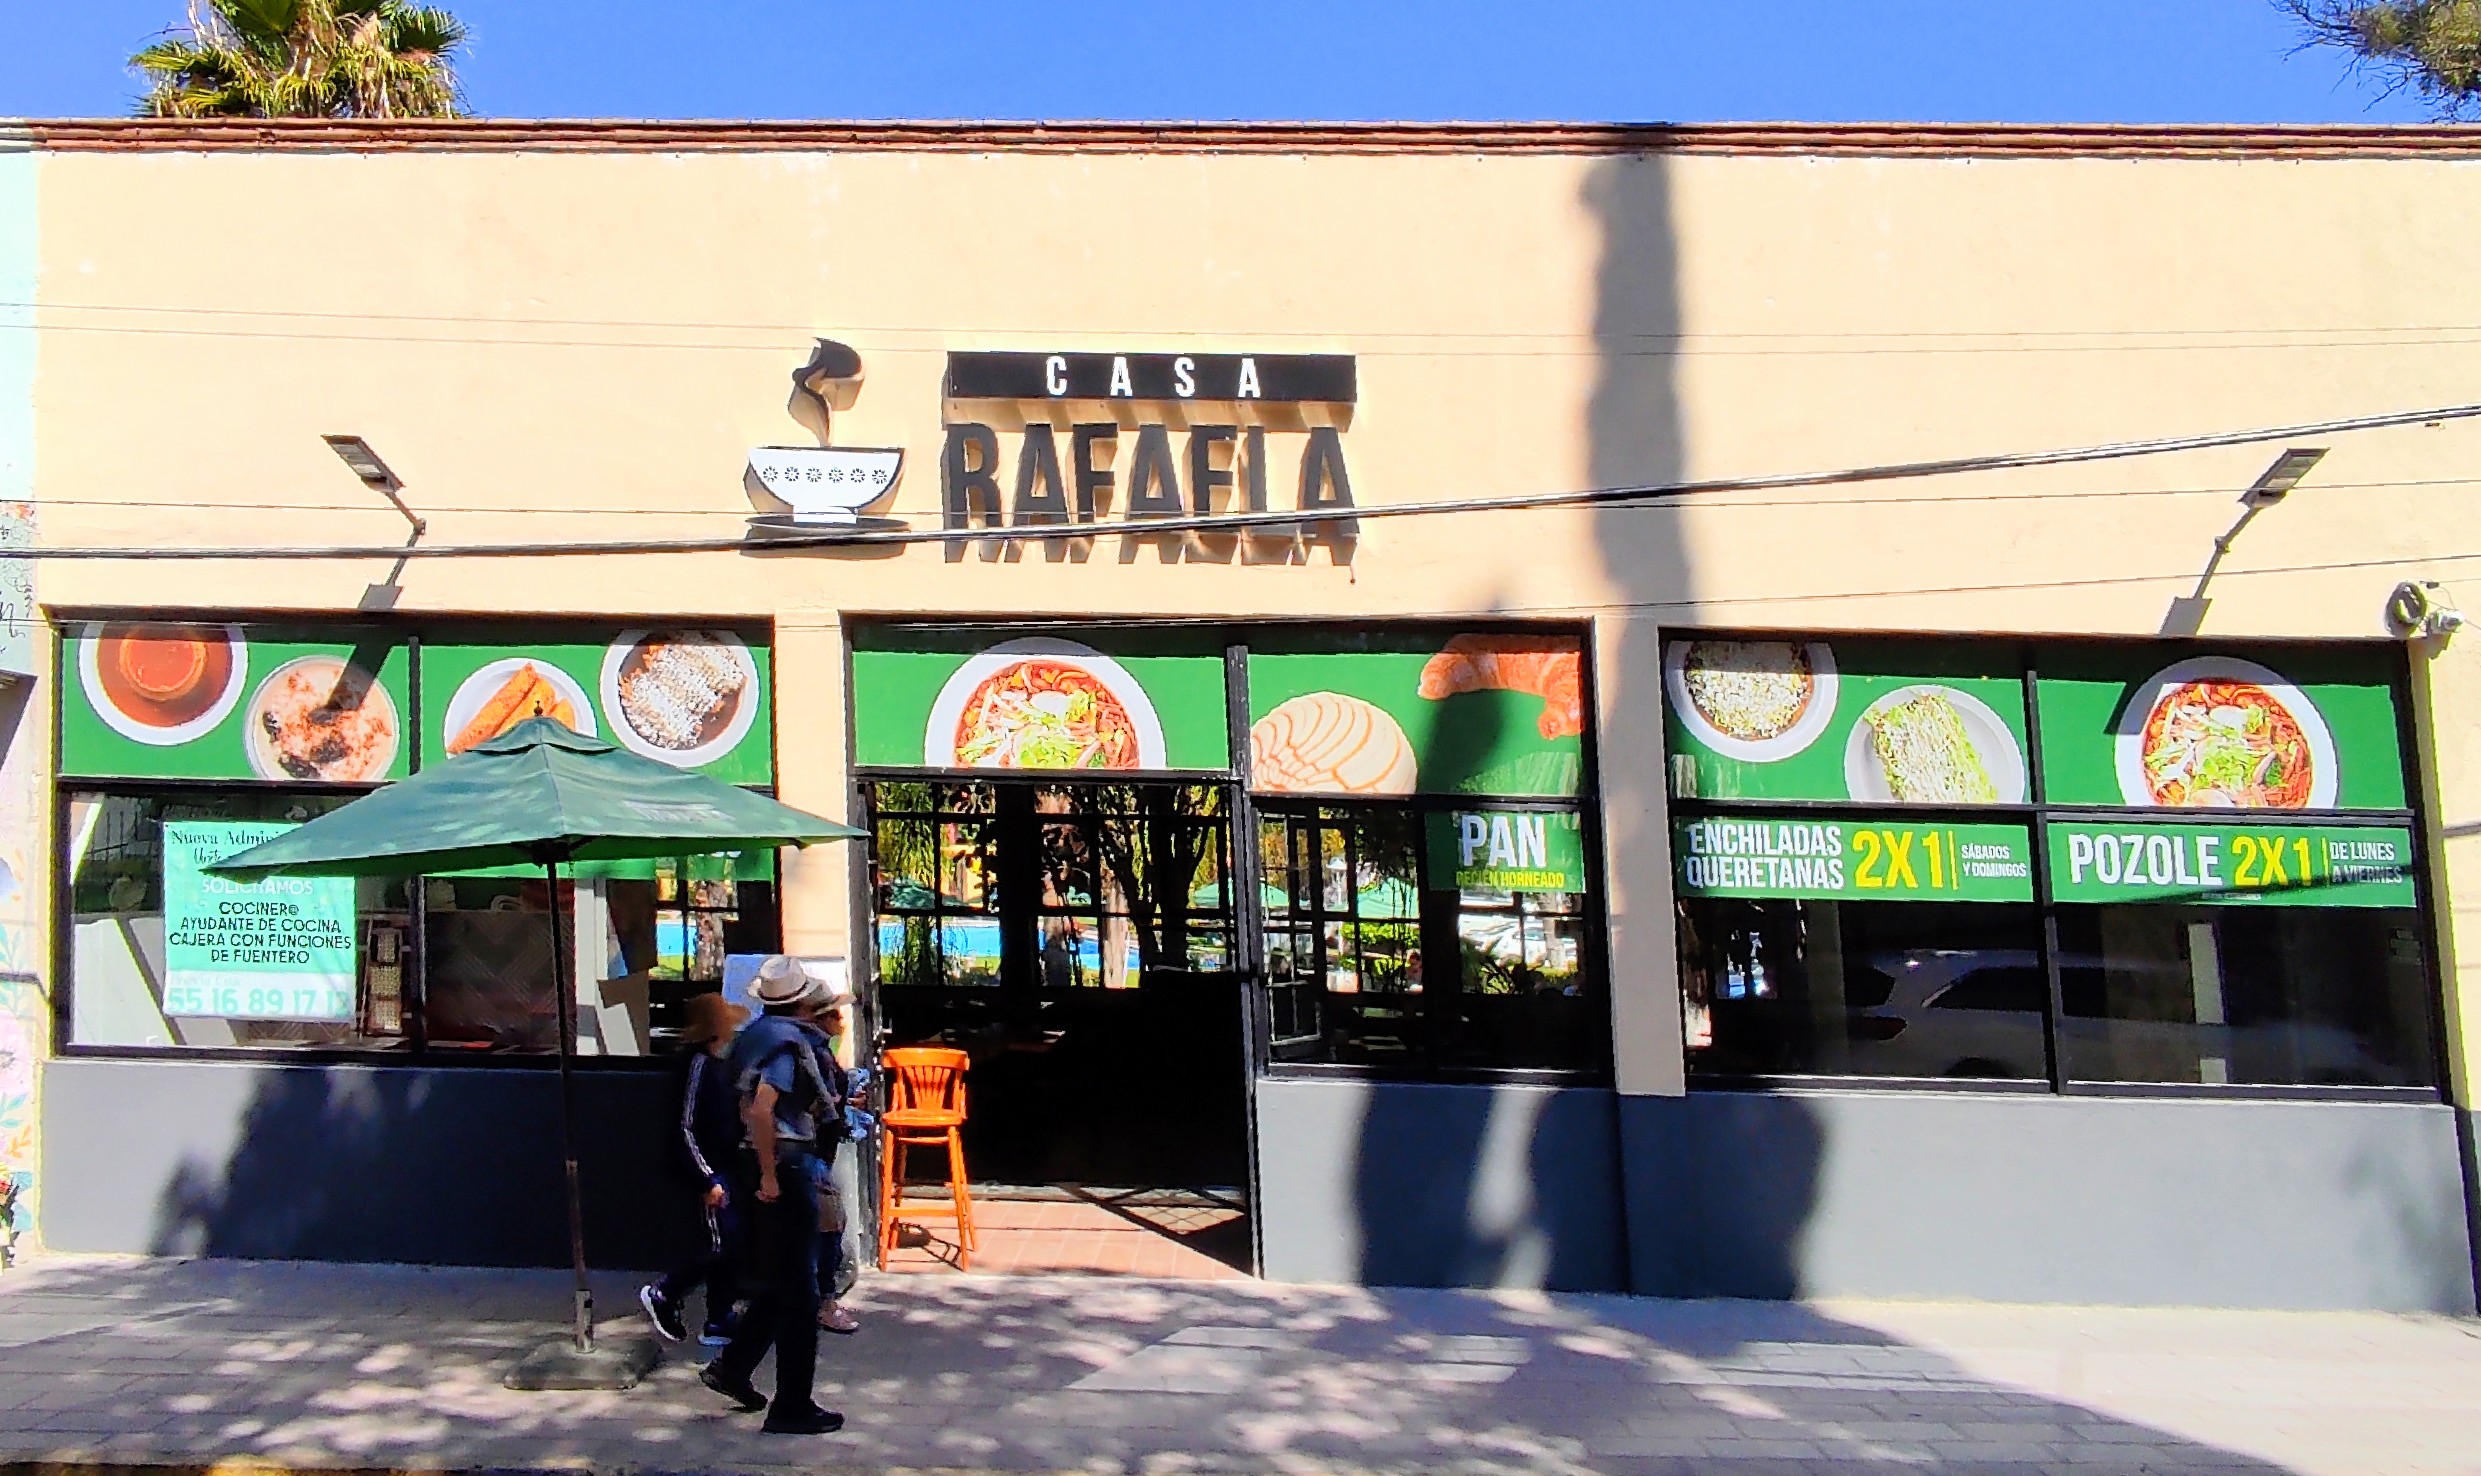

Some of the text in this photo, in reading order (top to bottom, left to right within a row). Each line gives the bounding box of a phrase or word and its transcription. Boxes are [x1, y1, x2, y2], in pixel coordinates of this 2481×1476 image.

[1046, 356, 1261, 398] CASA
[944, 423, 1358, 540] RAFAELA
[1461, 815, 1547, 868] PAN
[2329, 842, 2395, 861] DE LUNES
[1689, 823, 1943, 888] ENCHILADAS 2X1
[2068, 834, 2312, 886] POZOLE 2X1
[1500, 870, 1565, 888] HORNEADO
[1686, 857, 1845, 889] QUERETANAS
[1962, 861, 2027, 878] Y DOMINGOS
[2332, 865, 2403, 884] A VIERNES
[180, 917, 342, 933] AYUDANTE DE COCINA
[169, 932, 352, 949] CAJERA CON FUNCIONES
[211, 949, 310, 964] DE FUENTERO
[168, 987, 204, 1014] 55
[211, 987, 241, 1015] 16
[248, 987, 285, 1015] 89
[293, 989, 317, 1016] 17
